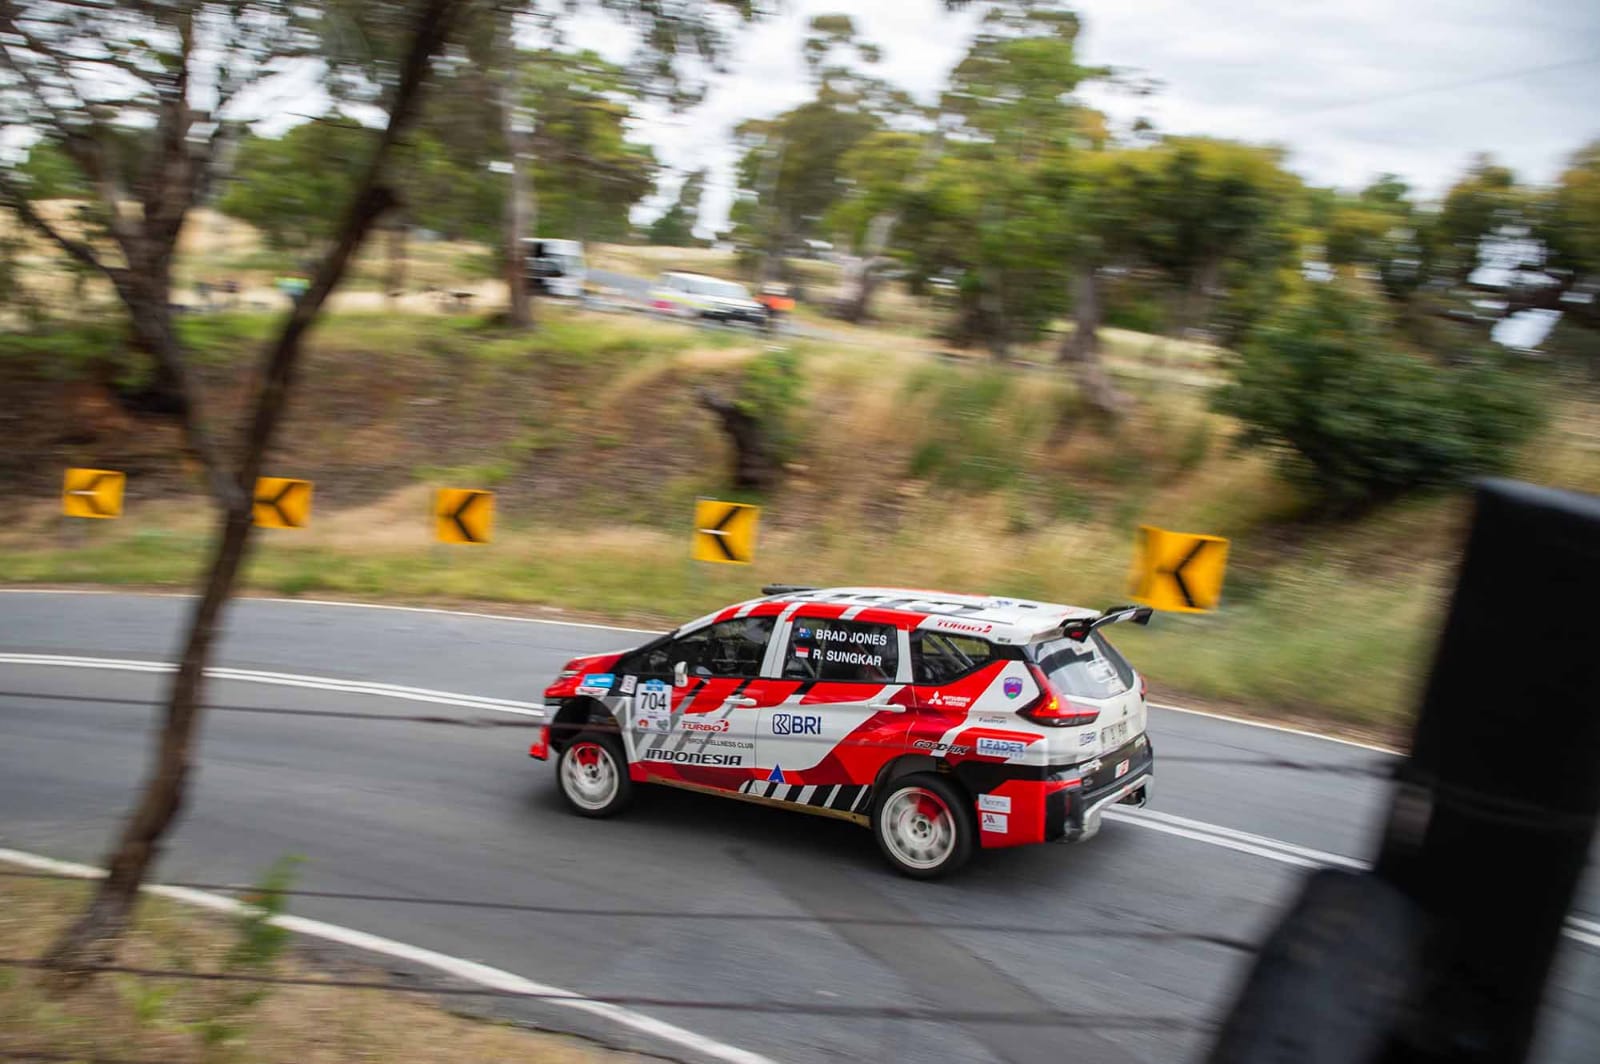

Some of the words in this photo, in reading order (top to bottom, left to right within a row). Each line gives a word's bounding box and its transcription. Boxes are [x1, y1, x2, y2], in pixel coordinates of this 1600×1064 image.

[816, 629, 847, 642] BRAD
[849, 632, 887, 646] JONES
[813, 649, 823, 660] R.
[826, 650, 881, 666] SUNGKAR
[641, 691, 666, 710] 704
[682, 722, 721, 732] TURBO
[792, 715, 821, 735] BRI
[980, 739, 1024, 753] LEADER
[646, 748, 742, 766] INDONESIA
